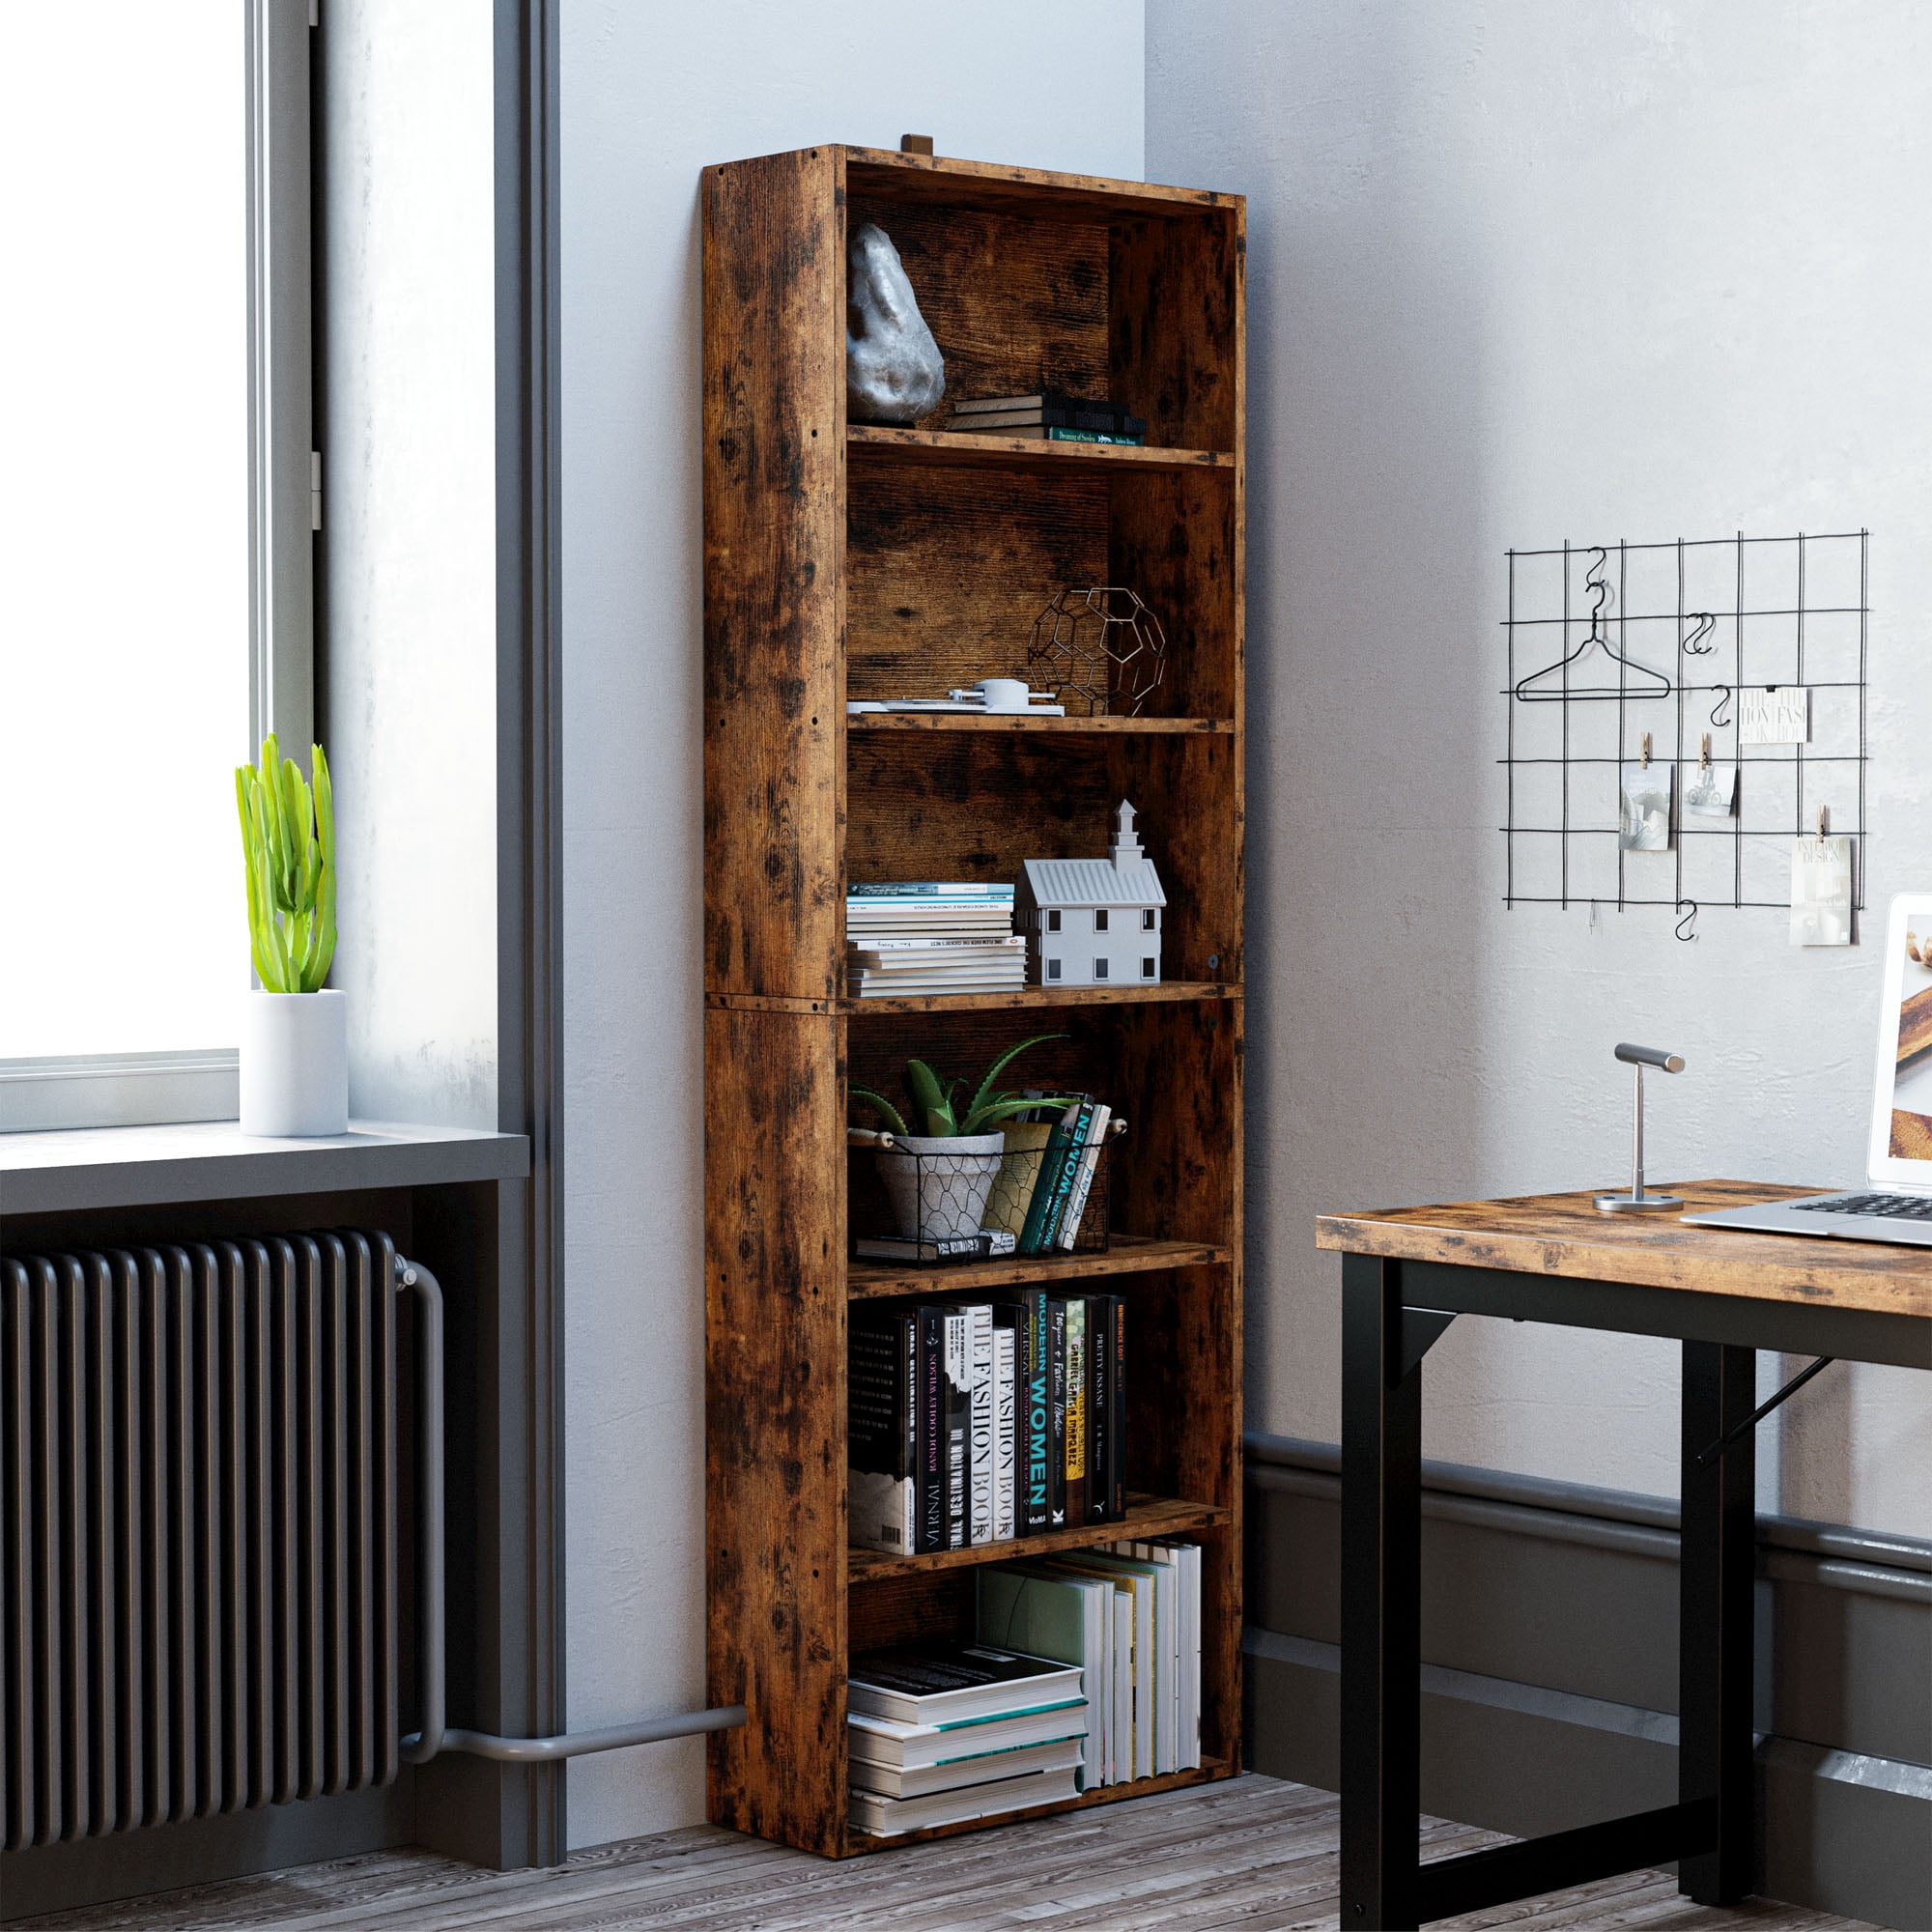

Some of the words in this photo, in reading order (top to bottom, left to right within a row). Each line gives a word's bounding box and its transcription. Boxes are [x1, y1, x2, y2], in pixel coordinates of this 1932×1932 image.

[1803, 850, 1839, 864] DESIGN
[1058, 1114, 1091, 1195] WOMEN
[973, 1306, 991, 1356] THE
[999, 1330, 1014, 1375] THE
[1037, 1293, 1047, 1372] MODERN
[928, 1353, 937, 1396] WILSON
[1070, 1344, 1079, 1379] GABRIEL
[928, 1397, 937, 1437] COOLEY
[950, 1428, 964, 1440] III
[973, 1362, 991, 1464] FASHION
[999, 1379, 1013, 1470] FASHION
[928, 1439, 937, 1472] RANDI
[1030, 1375, 1046, 1505] WOMEN
[950, 1444, 964, 1517] DESTINATION
